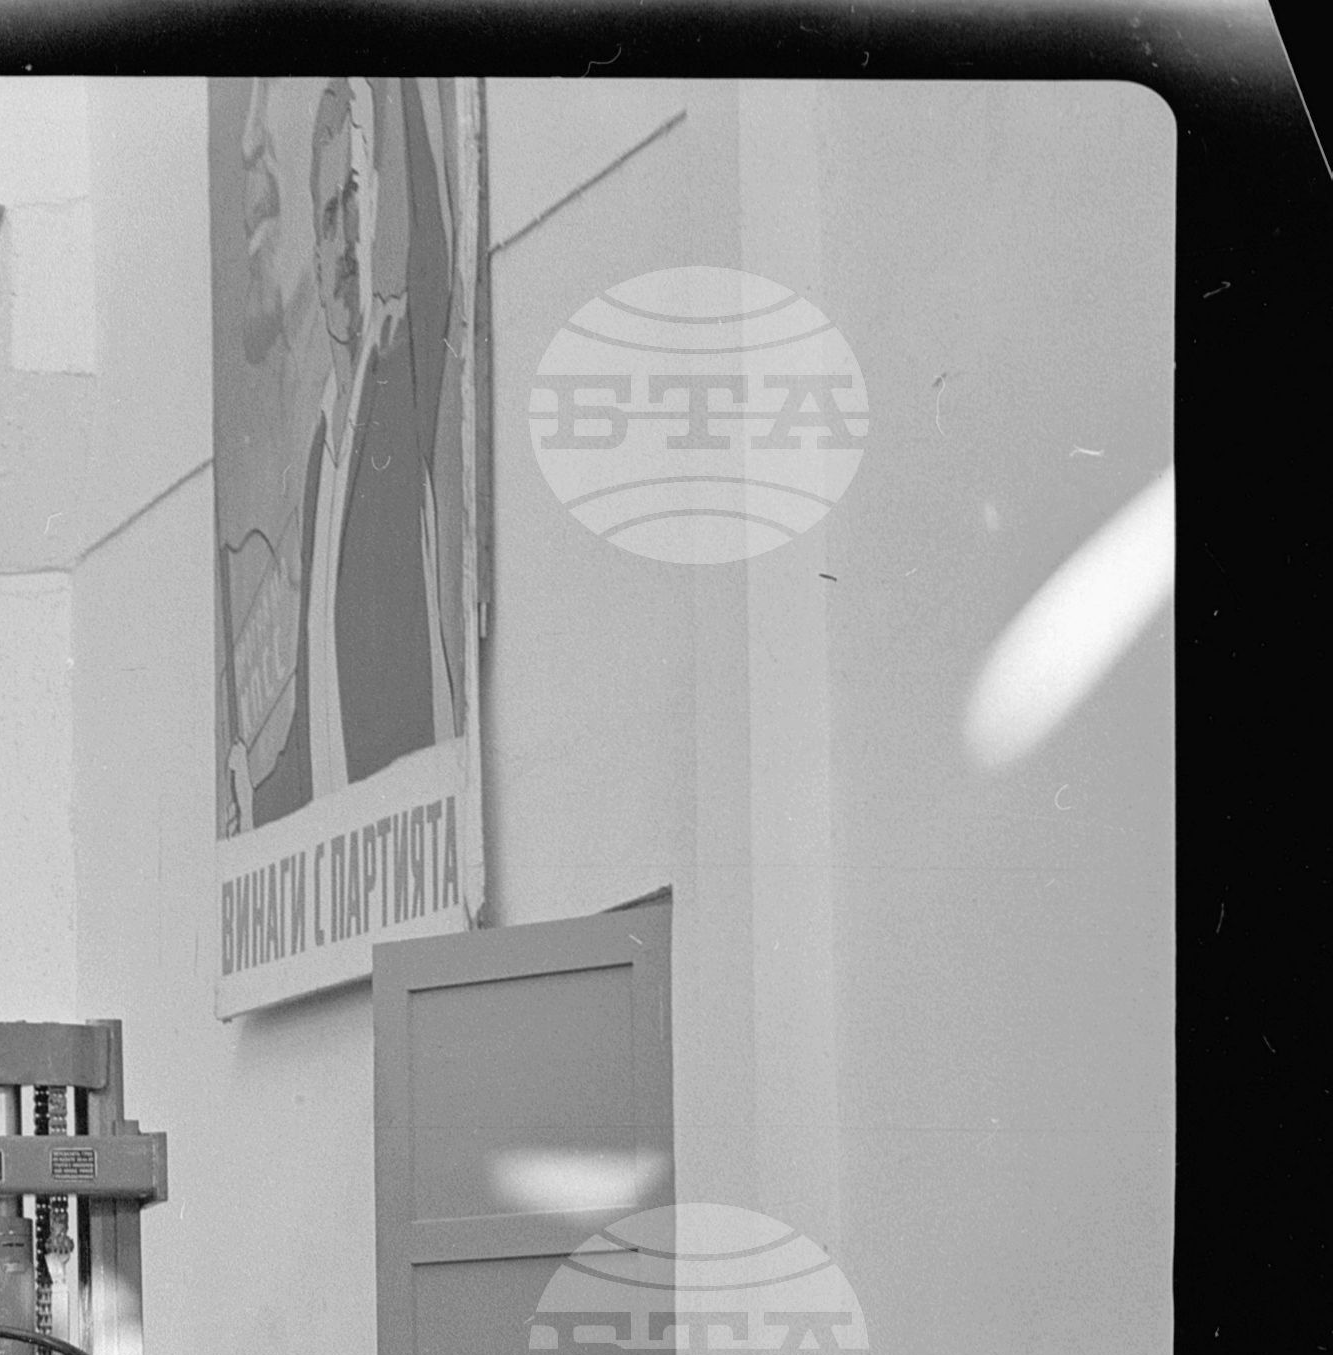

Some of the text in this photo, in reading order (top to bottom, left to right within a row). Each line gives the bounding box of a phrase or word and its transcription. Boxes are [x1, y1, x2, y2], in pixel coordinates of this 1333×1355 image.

[222, 796, 459, 976] ВИНАГИ С ПАРТИЯТА
